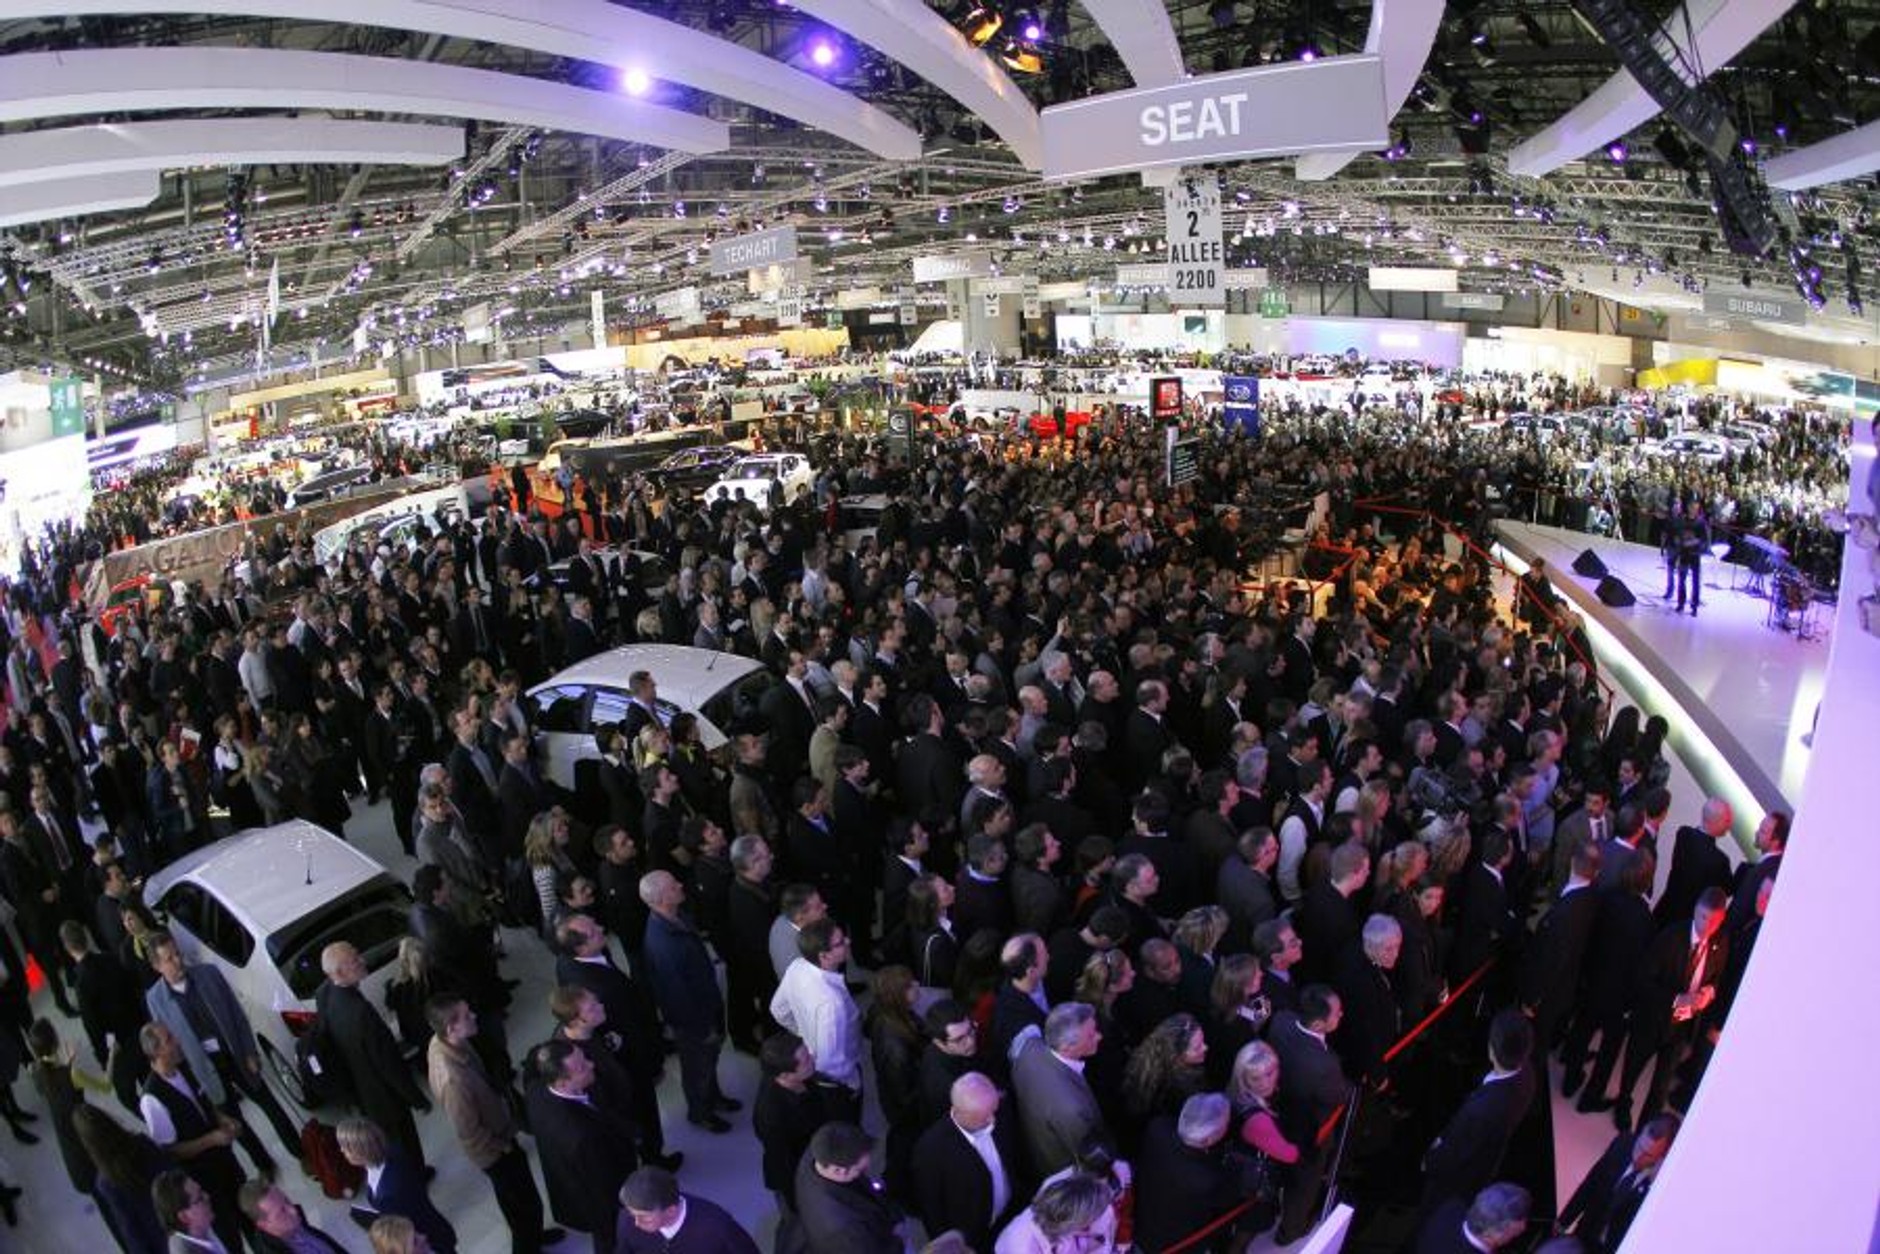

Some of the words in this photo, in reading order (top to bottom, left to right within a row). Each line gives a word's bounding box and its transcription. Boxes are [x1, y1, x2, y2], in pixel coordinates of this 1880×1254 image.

[1140, 93, 1248, 146] SEAT
[1187, 211, 1200, 238] 2
[724, 237, 777, 265] TECHART
[1171, 242, 1221, 264] ALLEE
[1176, 269, 1216, 290] 2200
[1727, 299, 1782, 317] SUBARU
